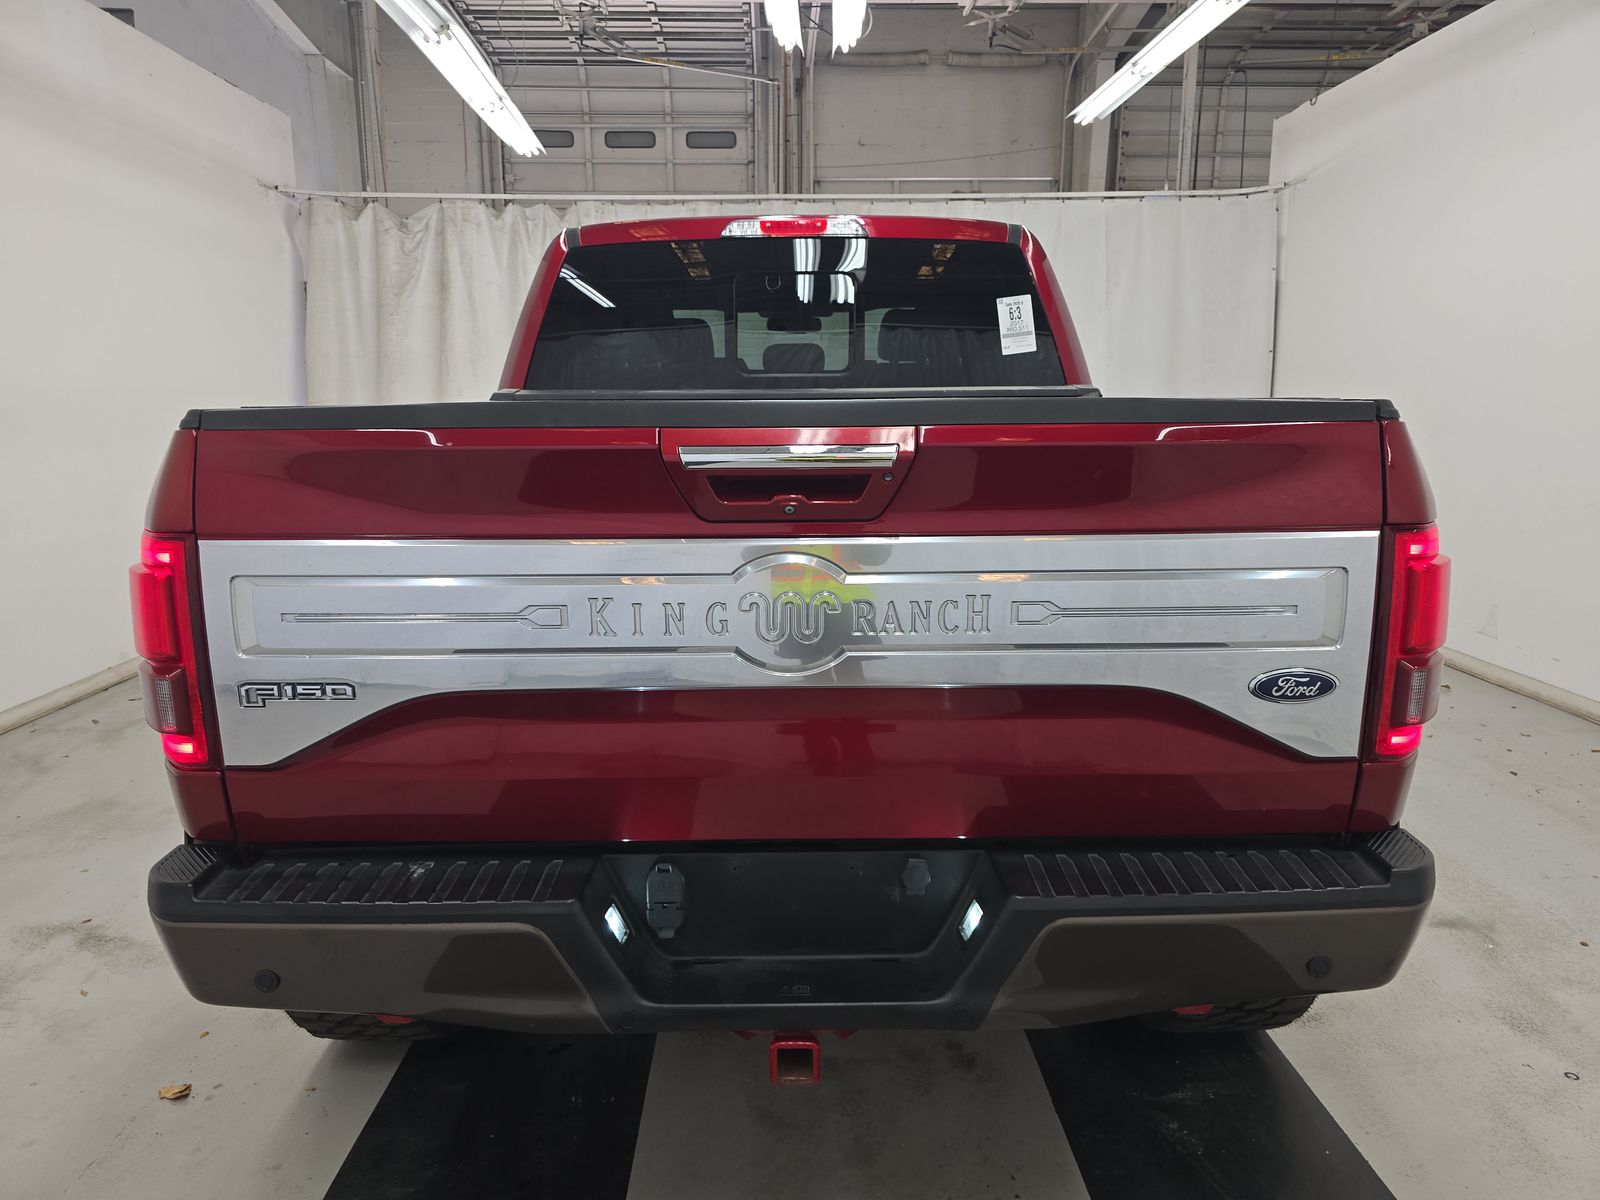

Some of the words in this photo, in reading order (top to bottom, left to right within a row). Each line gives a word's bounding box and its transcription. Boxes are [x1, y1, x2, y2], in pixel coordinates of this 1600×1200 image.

[1009, 306, 1021, 320] 6:3
[588, 597, 729, 637] KING
[851, 594, 991, 636] RANCH
[1272, 676, 1321, 696] Ford
